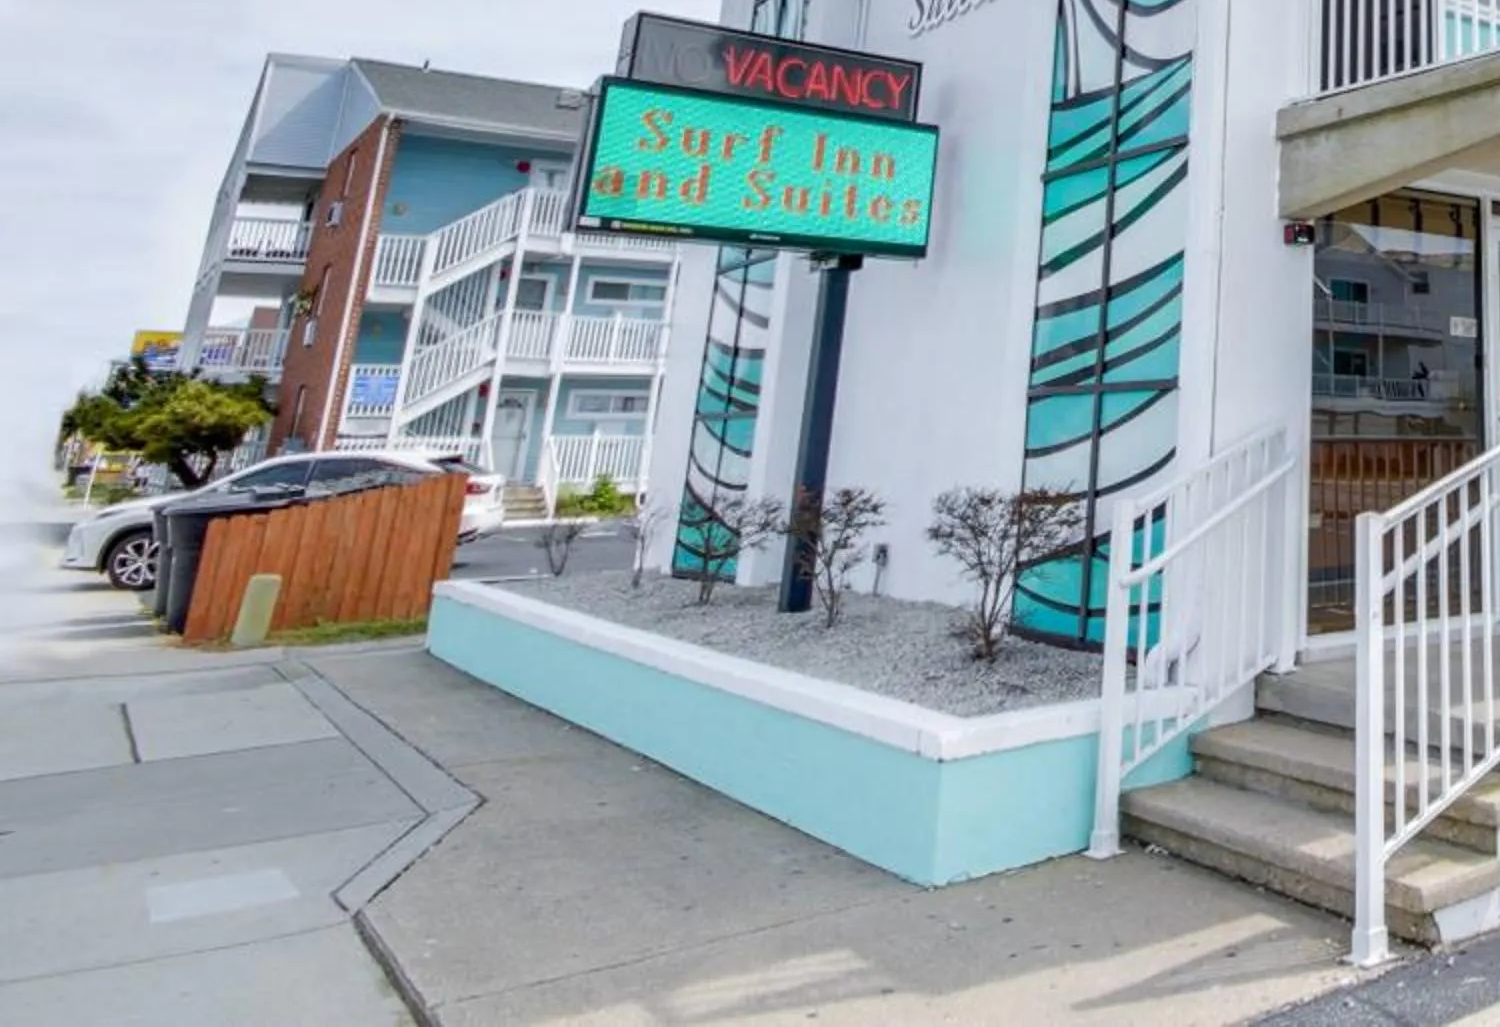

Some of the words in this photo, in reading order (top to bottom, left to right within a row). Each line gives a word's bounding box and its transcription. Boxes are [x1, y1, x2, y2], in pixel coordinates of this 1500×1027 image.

[636, 35, 714, 85] NO
[723, 44, 910, 110] VACANCY
[637, 109, 785, 164] Surf
[811, 133, 896, 181] Inn
[593, 163, 713, 206] and
[742, 169, 922, 226] Suites
